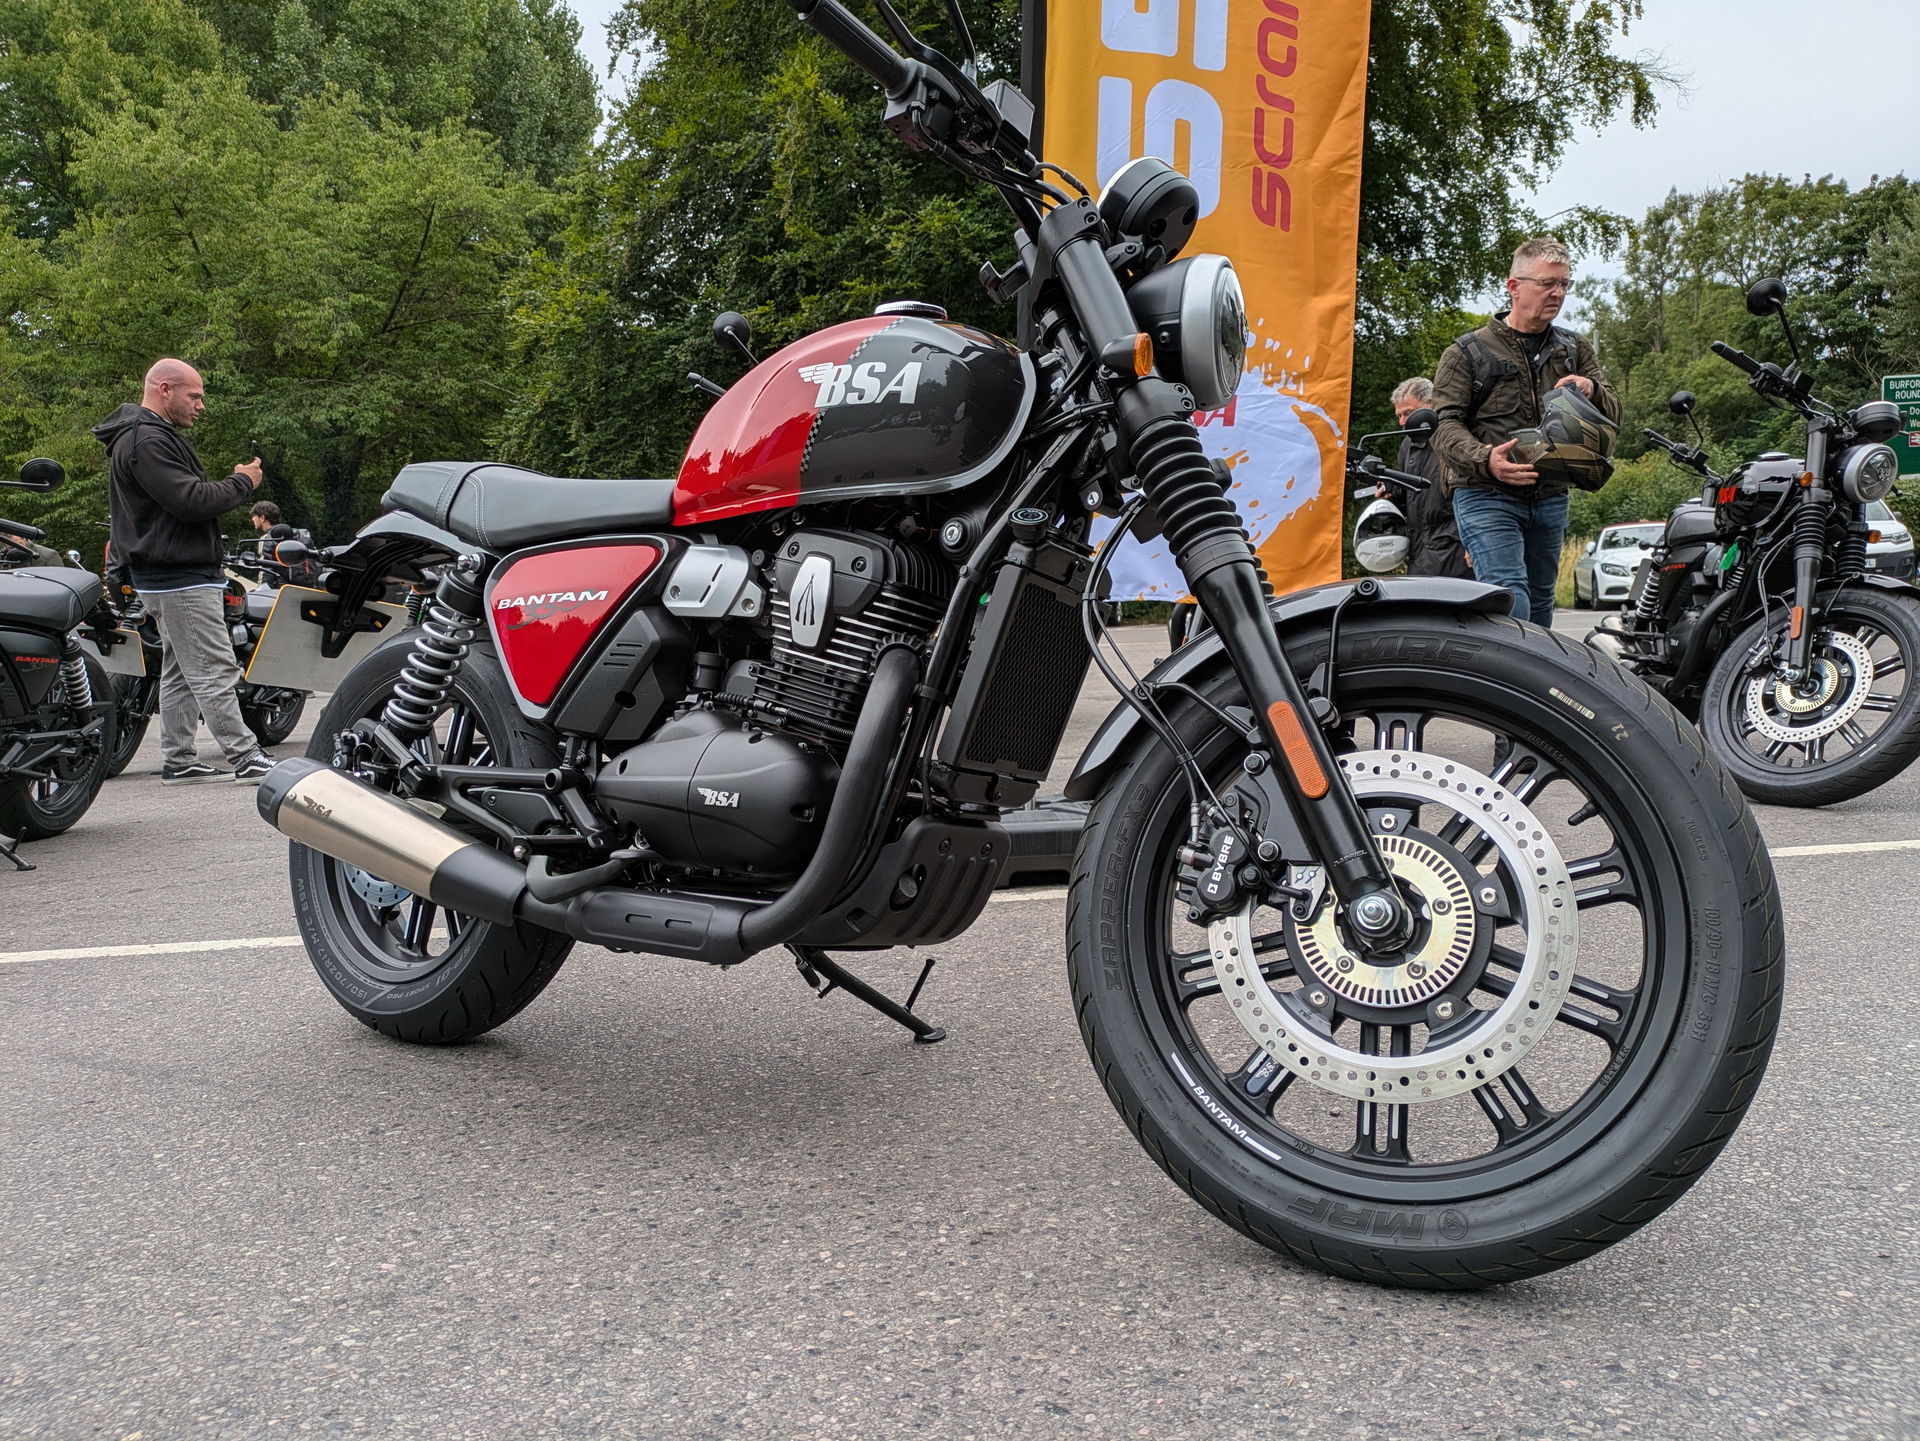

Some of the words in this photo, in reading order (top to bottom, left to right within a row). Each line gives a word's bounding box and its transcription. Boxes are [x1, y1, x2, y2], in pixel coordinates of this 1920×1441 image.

[798, 362, 923, 408] BSA
[497, 590, 609, 610] BANTAM
[15, 655, 59, 664] BANTAM
[1350, 635, 1483, 663] MRF
[303, 794, 333, 819] BSA
[697, 787, 740, 808] BSA
[1211, 835, 1235, 882] BYBRE
[1193, 1085, 1248, 1138] BANTAM
[1287, 1196, 1426, 1240] MRF
